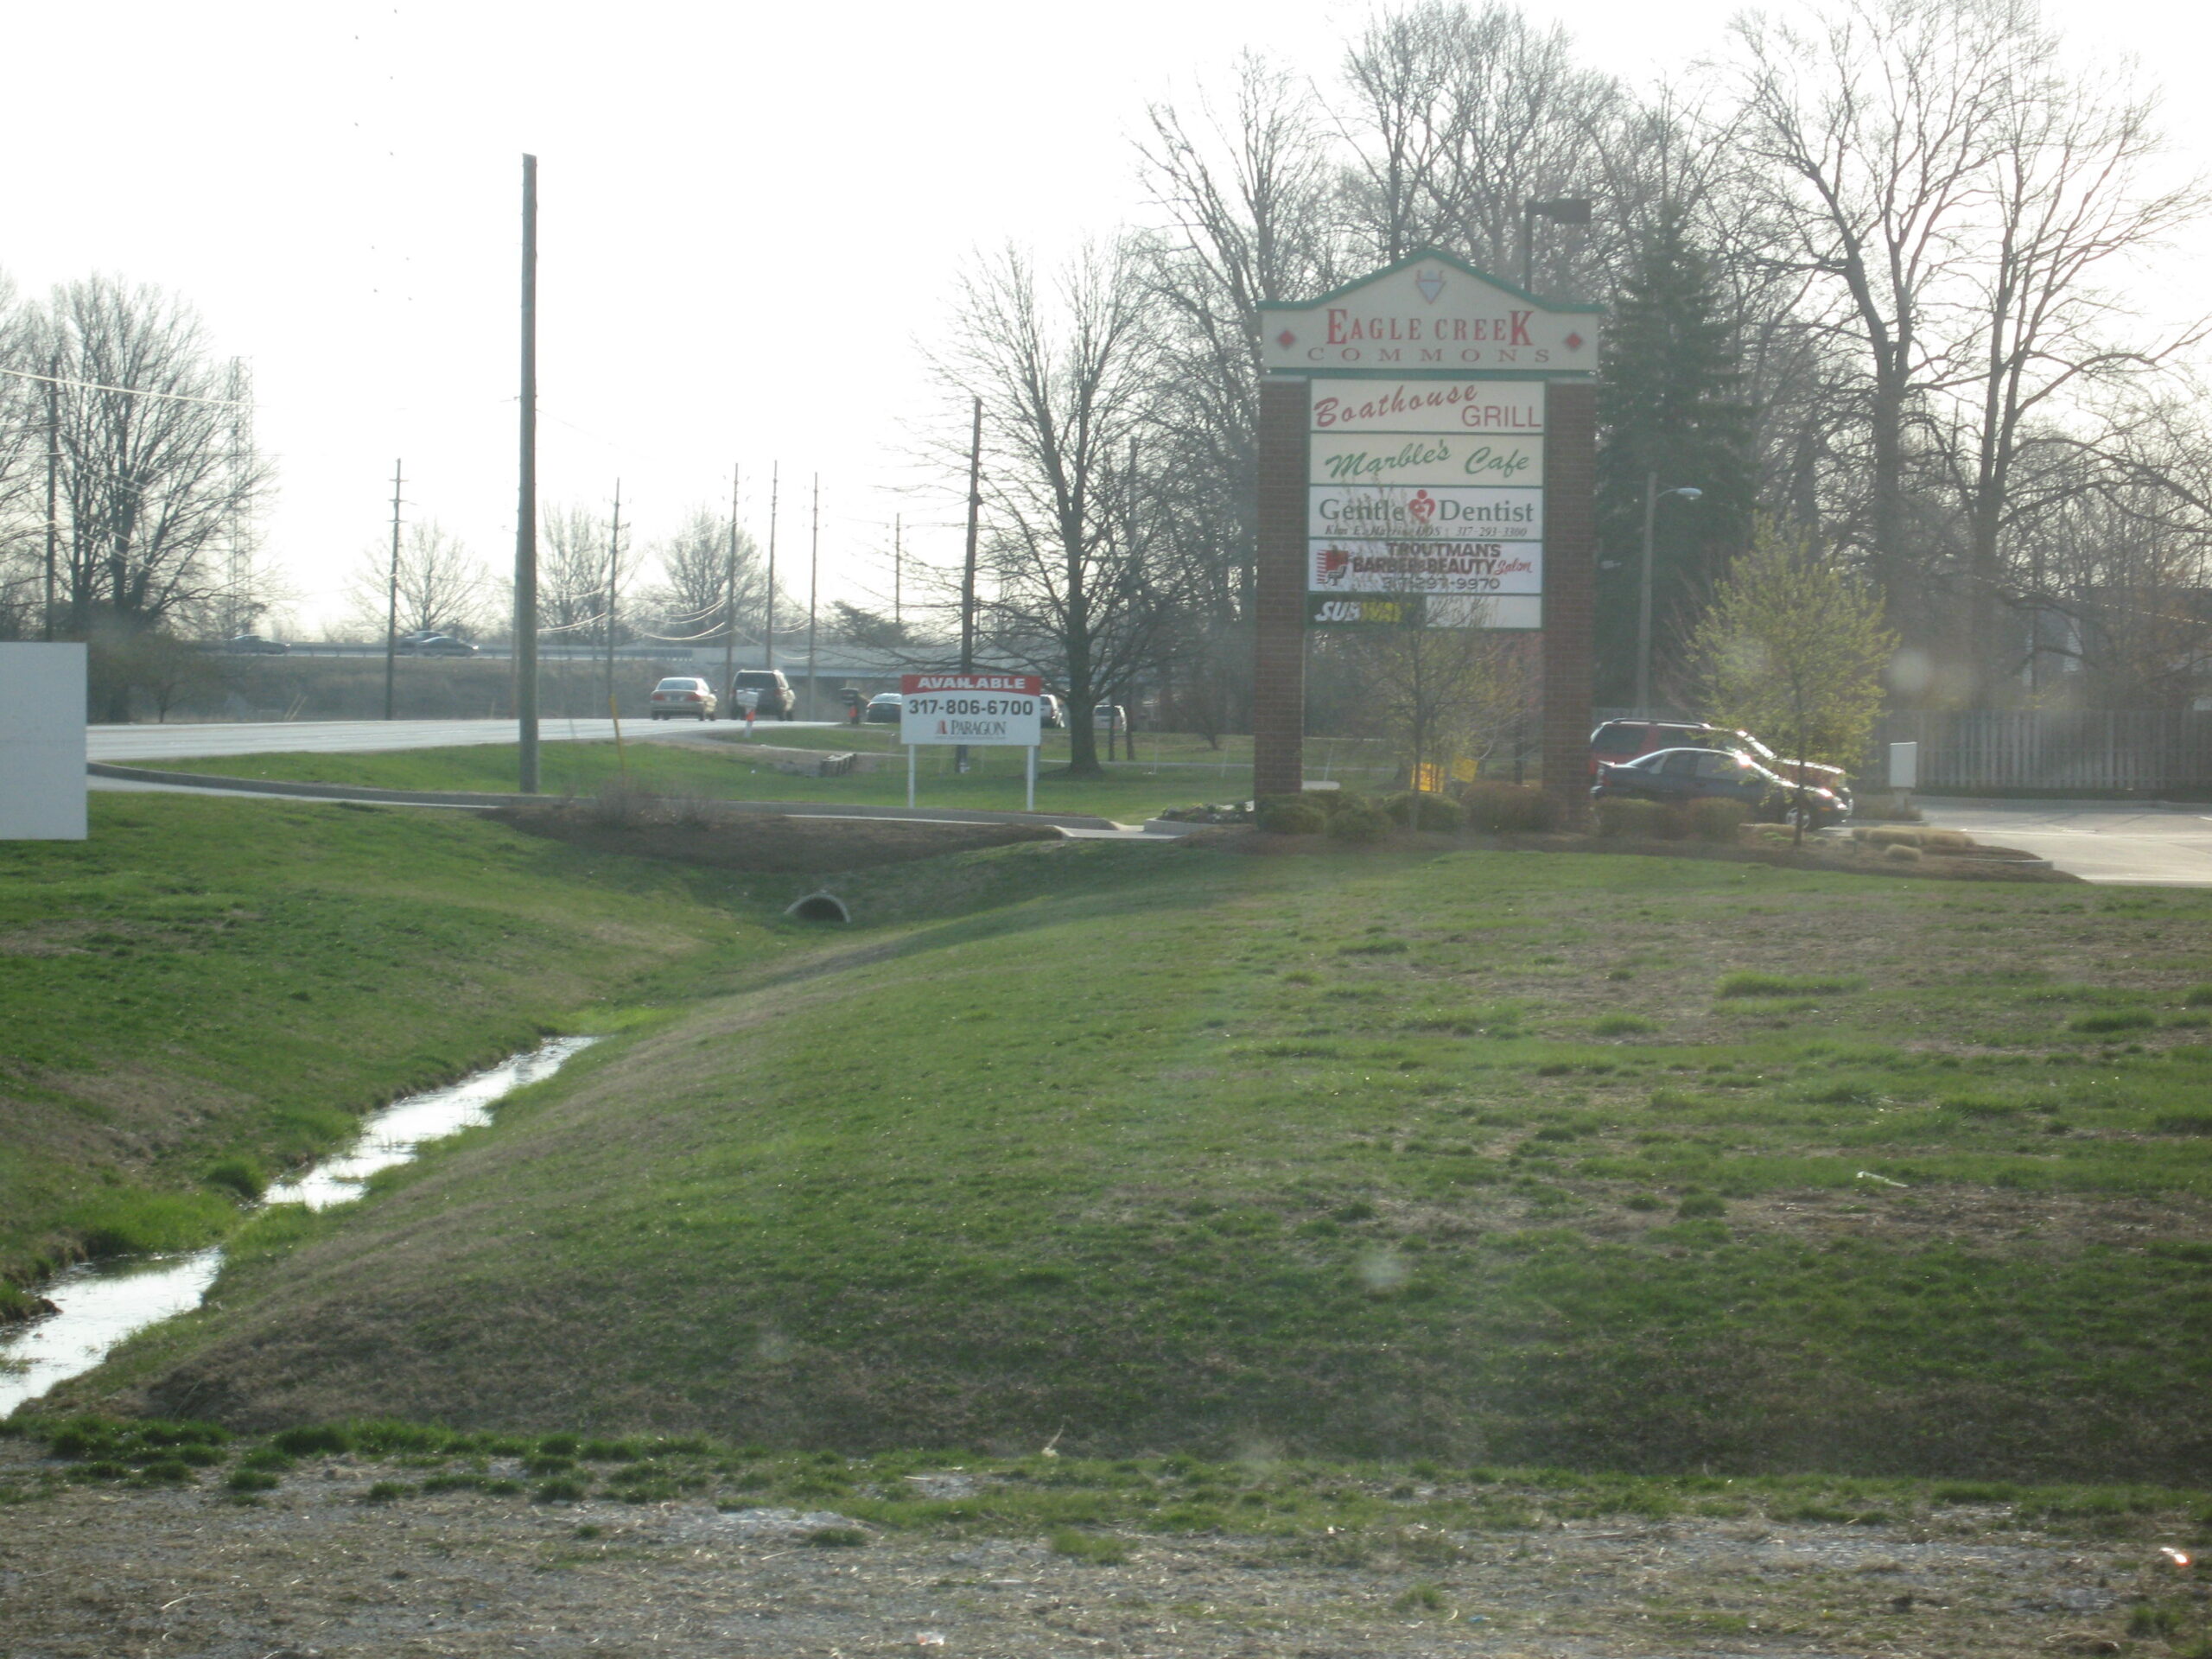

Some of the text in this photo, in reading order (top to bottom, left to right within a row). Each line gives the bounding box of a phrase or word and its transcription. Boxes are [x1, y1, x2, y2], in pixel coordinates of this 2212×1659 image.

[1326, 308, 1534, 346] EAGLE CREEK
[1307, 346, 1550, 363] COMMONS
[1313, 385, 1541, 428] Boathouse GRILL
[1325, 439, 1529, 479] Marble's Cafe
[1319, 498, 1534, 523] Gentle Dentist
[918, 677, 1026, 690] AVAILABLE
[909, 699, 1033, 715] 317-806-6700
[951, 720, 1007, 735] PARAGON
